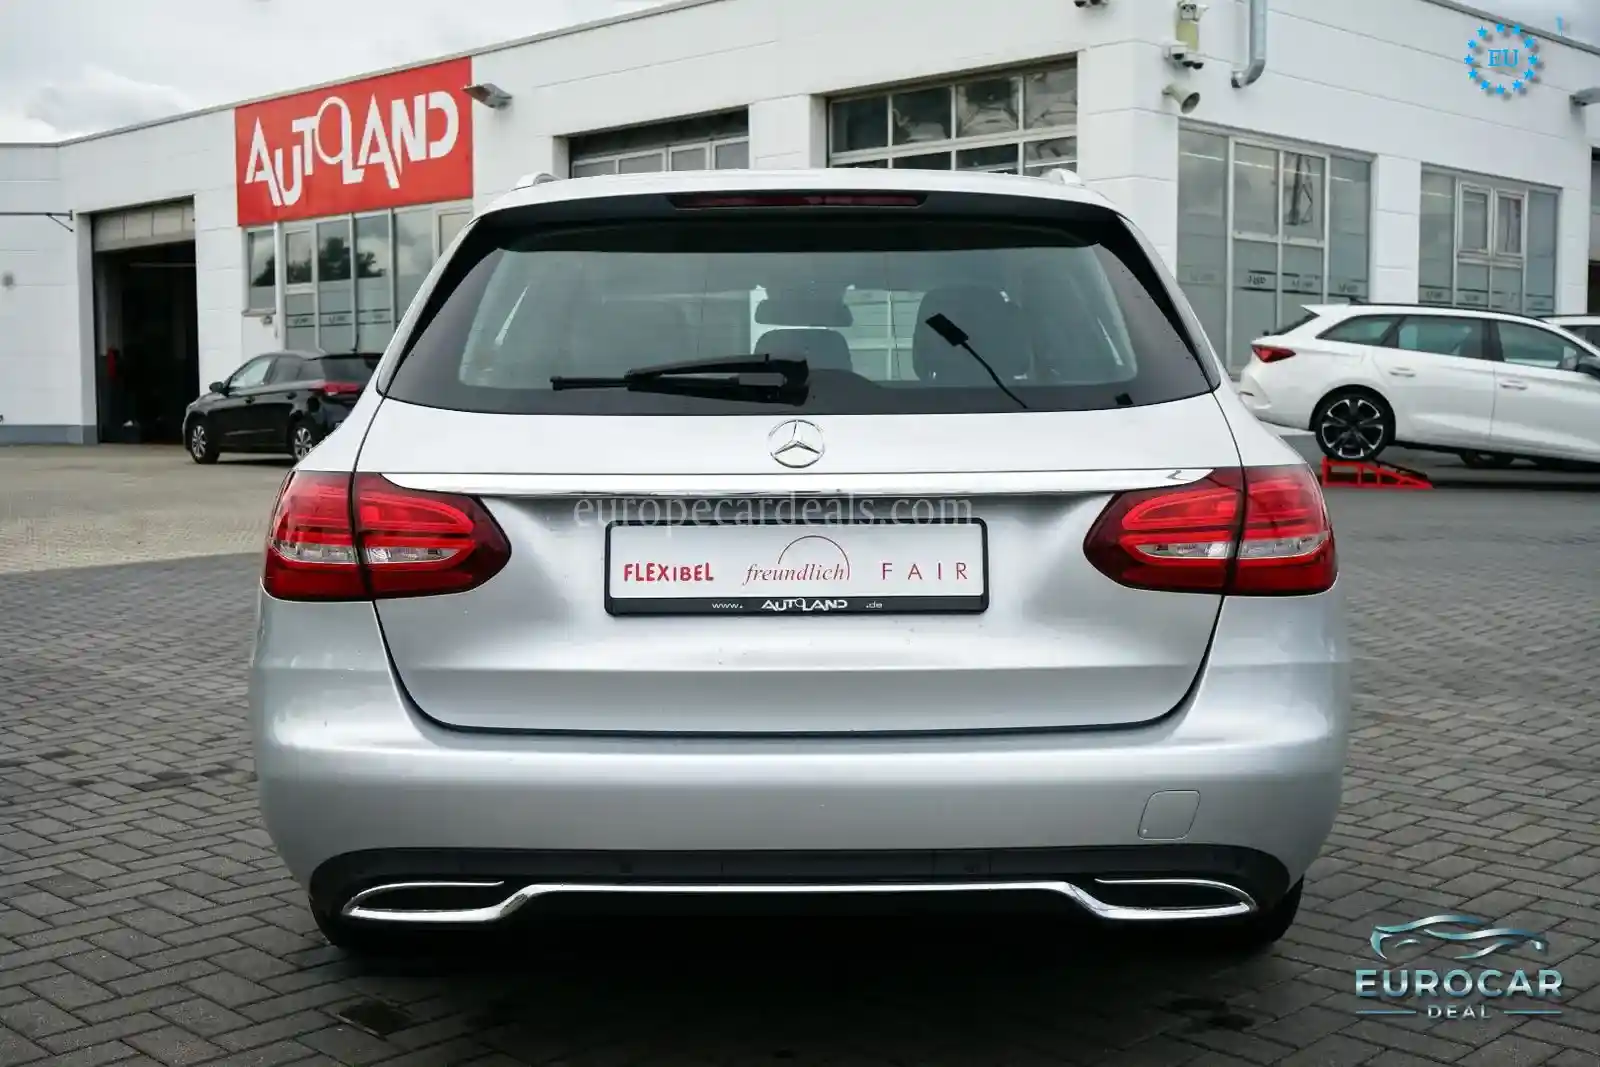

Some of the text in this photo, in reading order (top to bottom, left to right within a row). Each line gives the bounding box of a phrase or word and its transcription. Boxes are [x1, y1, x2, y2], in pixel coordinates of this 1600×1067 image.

[245, 91, 459, 207] AUTOLAND
[623, 562, 968, 586] FLEXIBEL freundlich FAIR
[711, 598, 883, 612] www. AUTOLAND .de
